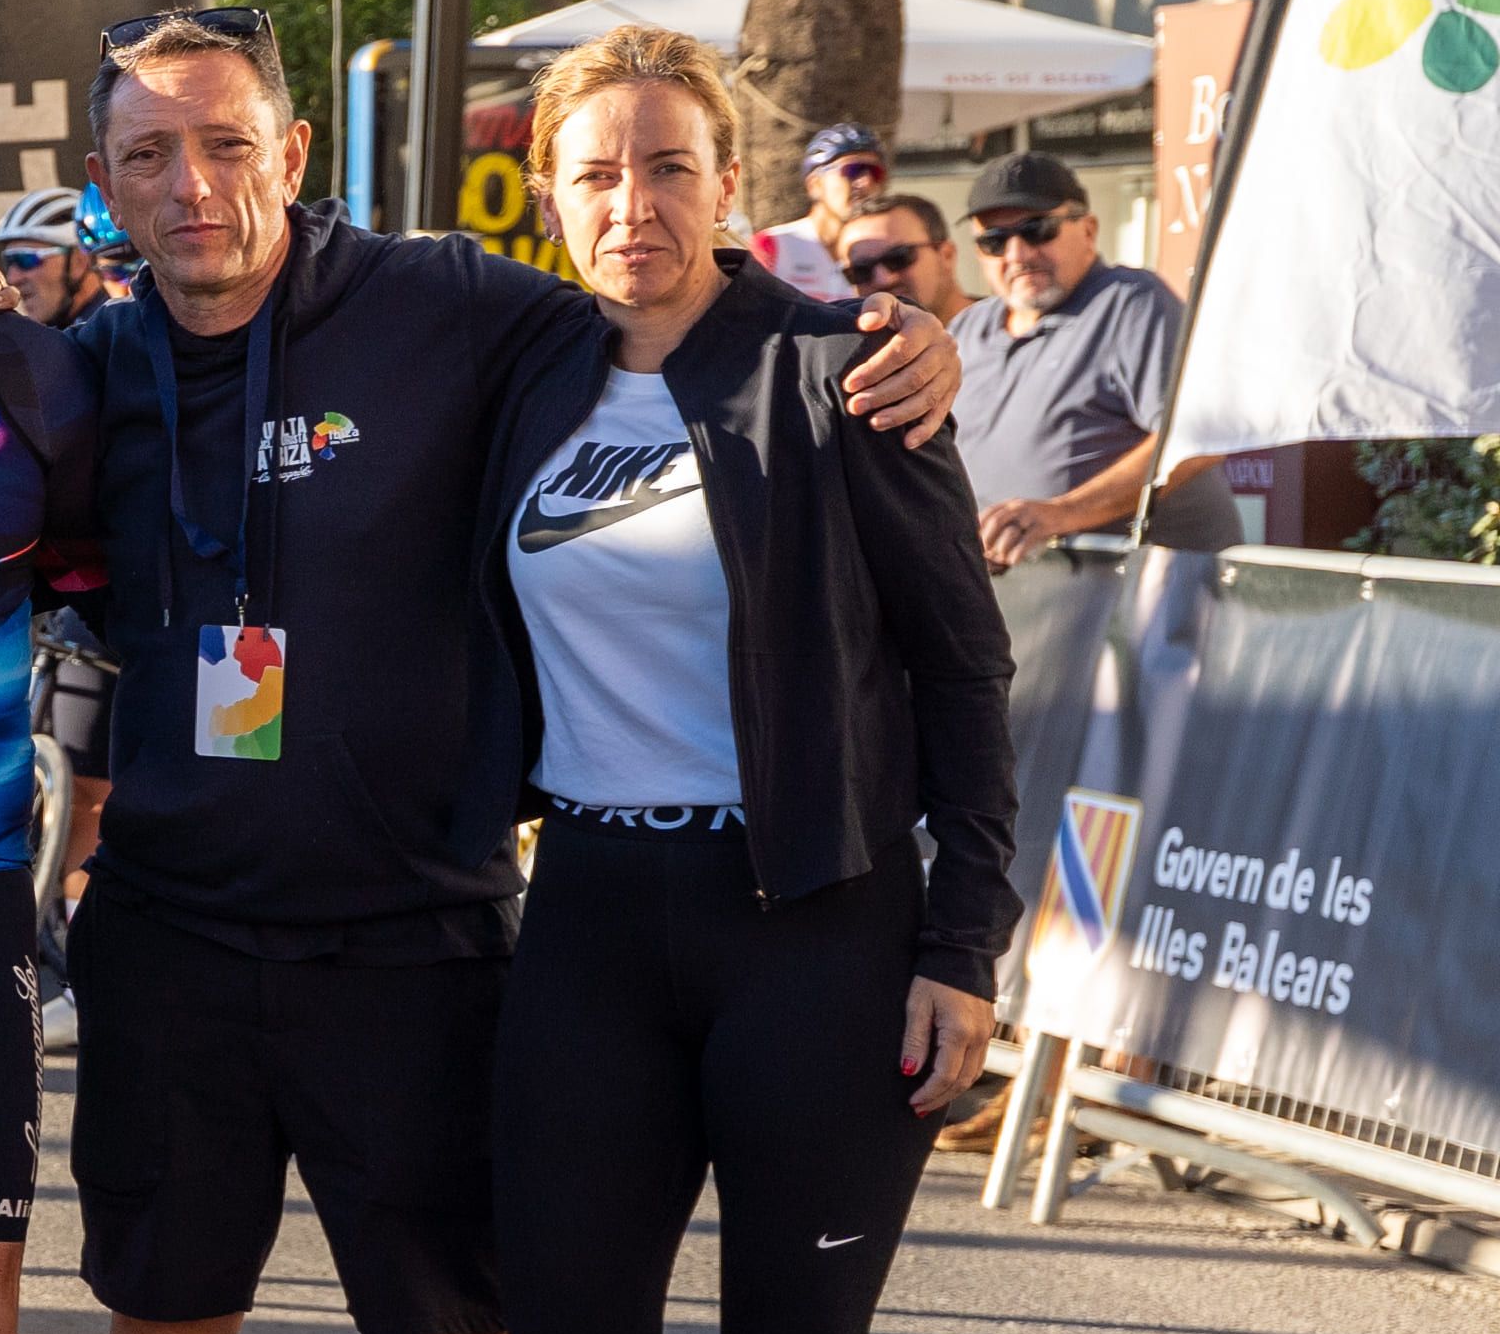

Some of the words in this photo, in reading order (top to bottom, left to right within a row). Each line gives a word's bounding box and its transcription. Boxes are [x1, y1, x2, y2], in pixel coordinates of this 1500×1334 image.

[541, 441, 692, 501] NIKE
[1156, 825, 1263, 905] Govern
[1267, 848, 1317, 913] de
[1320, 856, 1374, 926] les
[1131, 904, 1207, 982] Illes
[1212, 922, 1354, 1015] Balears
